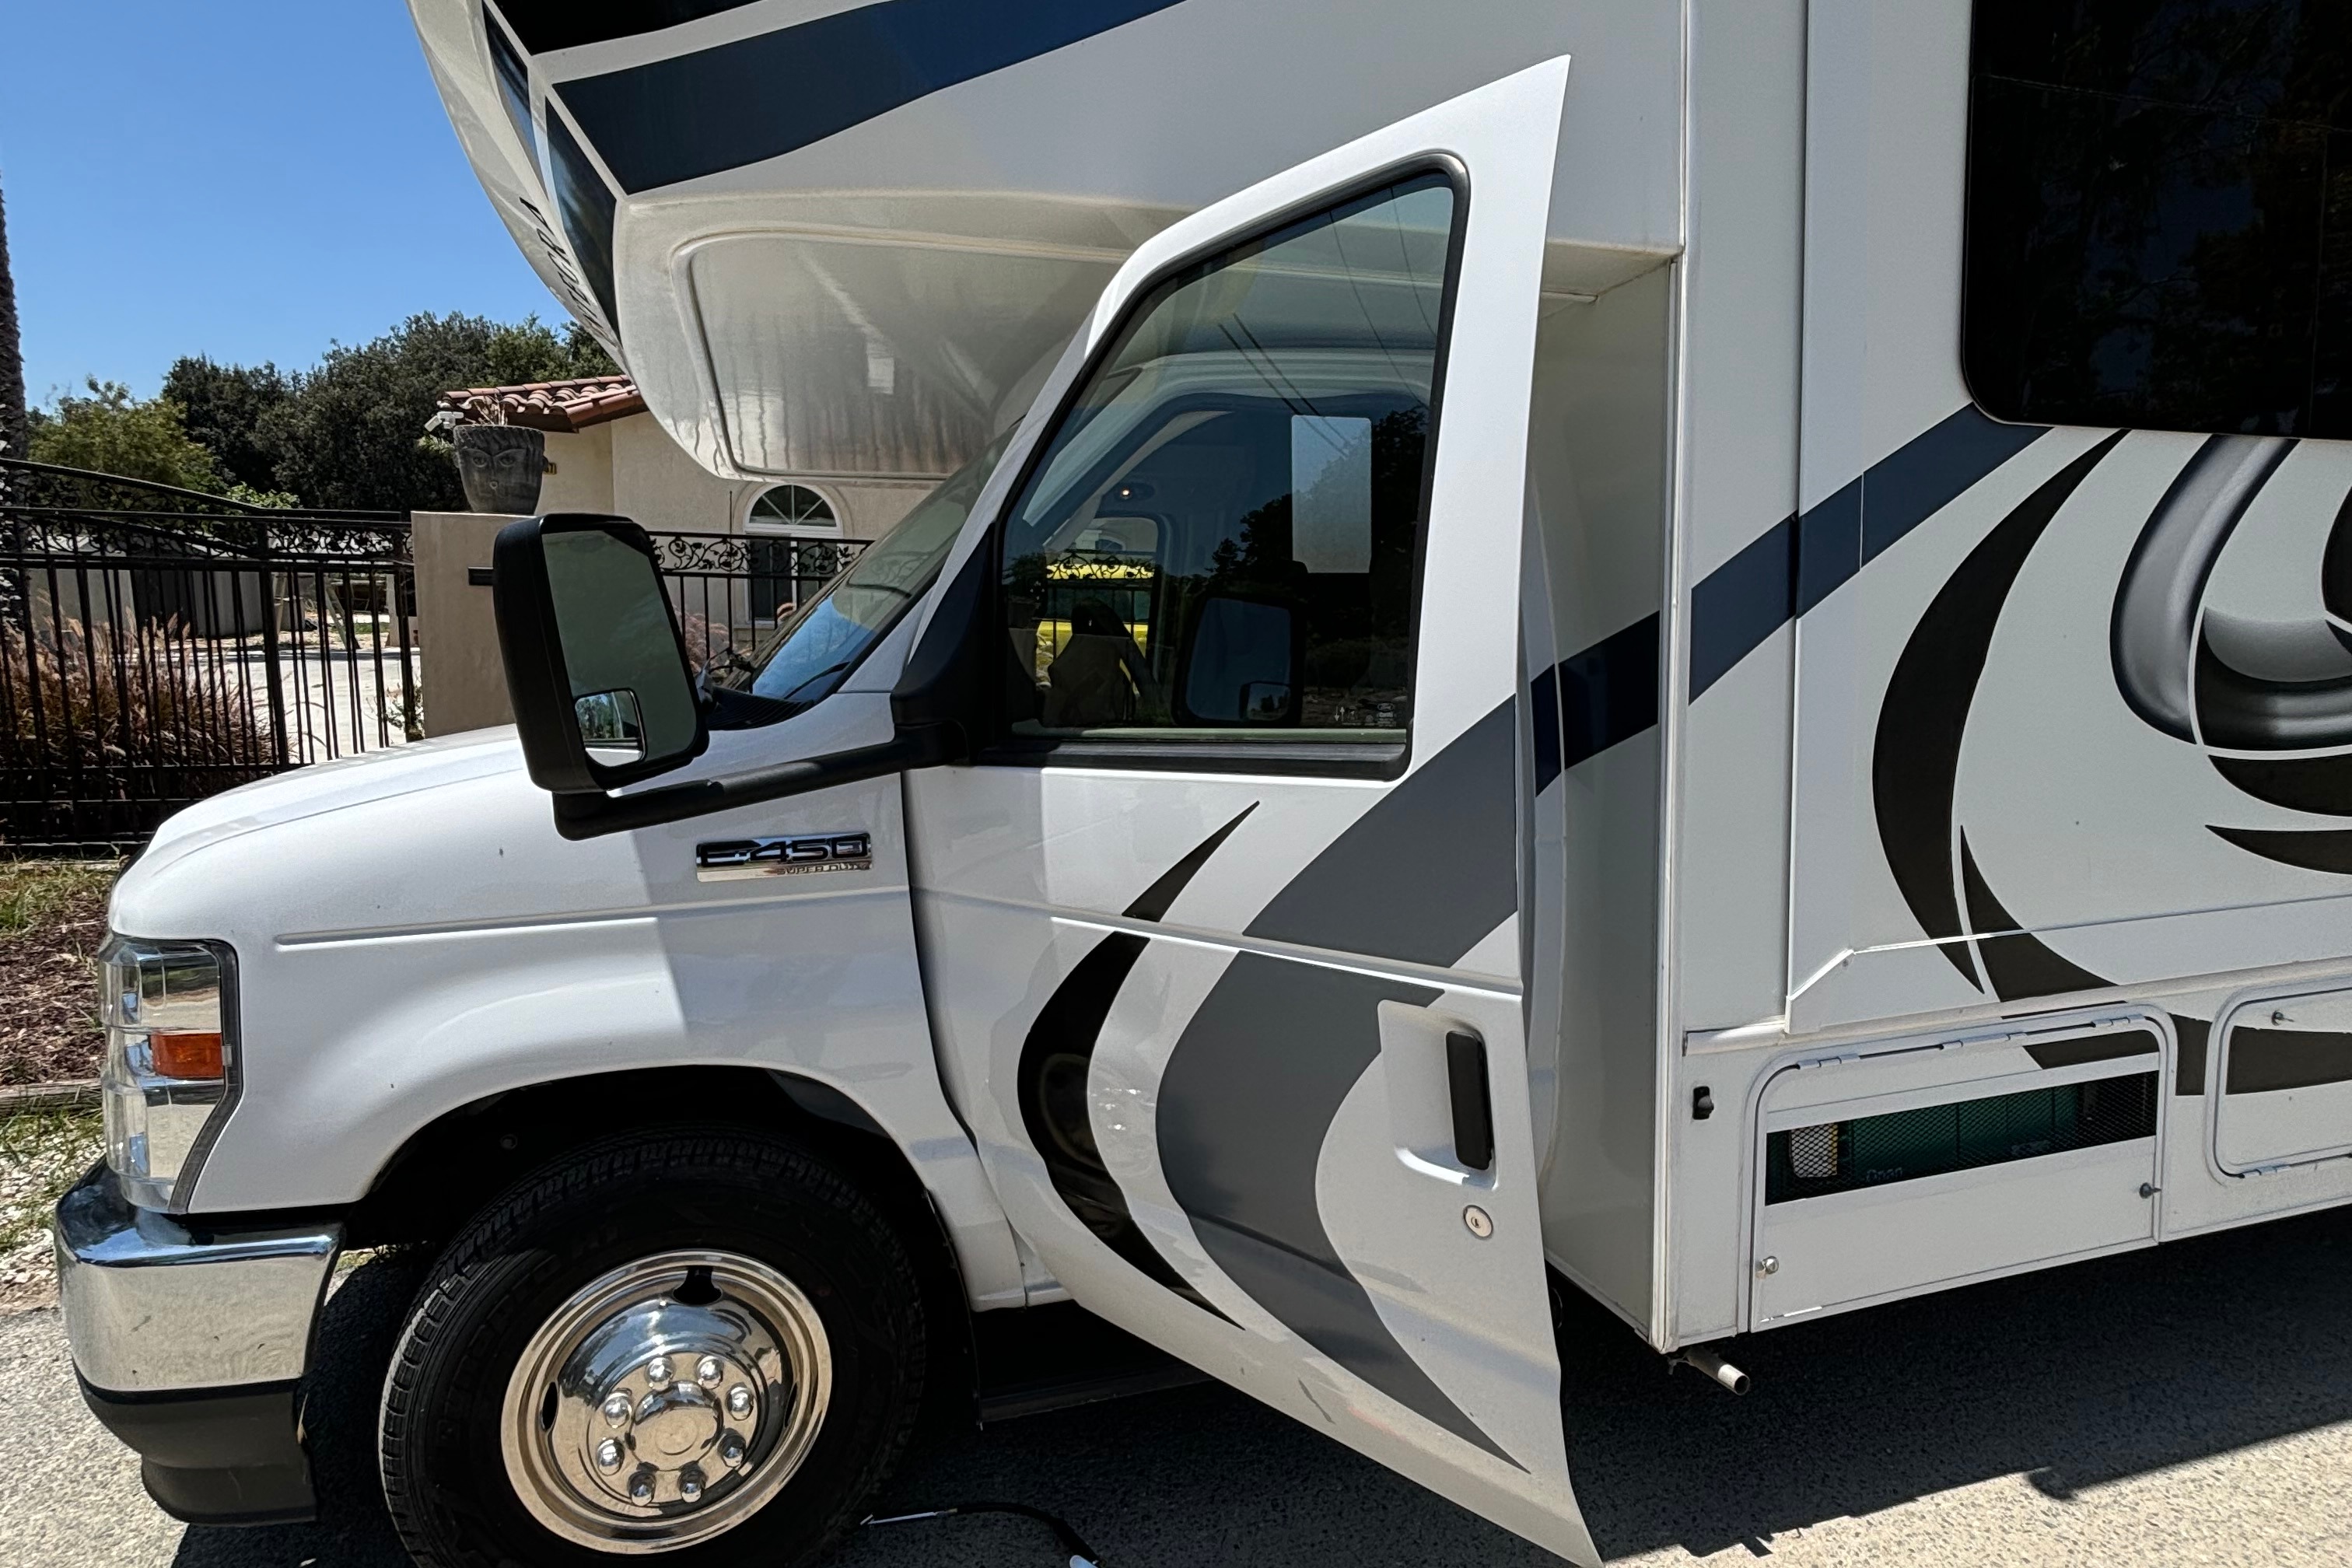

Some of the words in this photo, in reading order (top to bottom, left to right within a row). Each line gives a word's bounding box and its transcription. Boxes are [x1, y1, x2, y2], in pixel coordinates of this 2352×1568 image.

[700, 835, 869, 868] E-450
[776, 864, 825, 875] SUPER
[828, 860, 870, 872] DUTY
